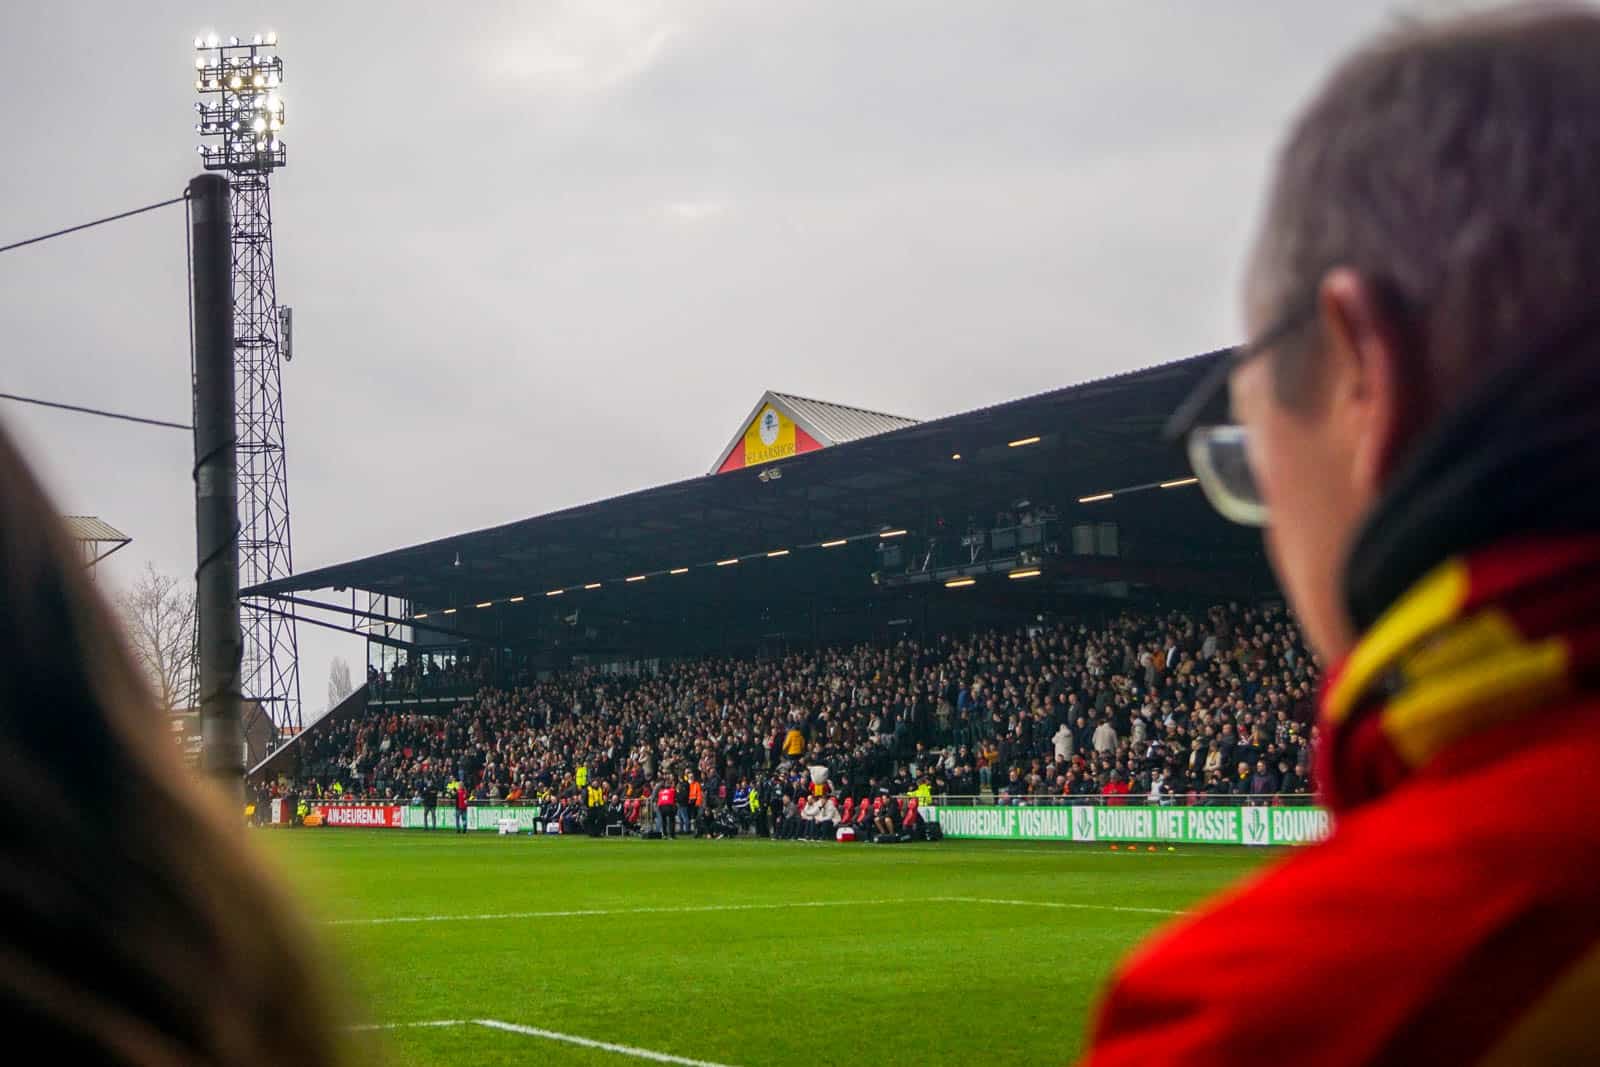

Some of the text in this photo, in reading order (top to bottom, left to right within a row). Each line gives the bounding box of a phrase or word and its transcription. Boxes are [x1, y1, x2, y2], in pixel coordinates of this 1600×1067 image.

[938, 809, 1068, 836] BOUWBEDRIJF VOSMAN
[1098, 809, 1237, 841] BOUWEN MET PASSIE
